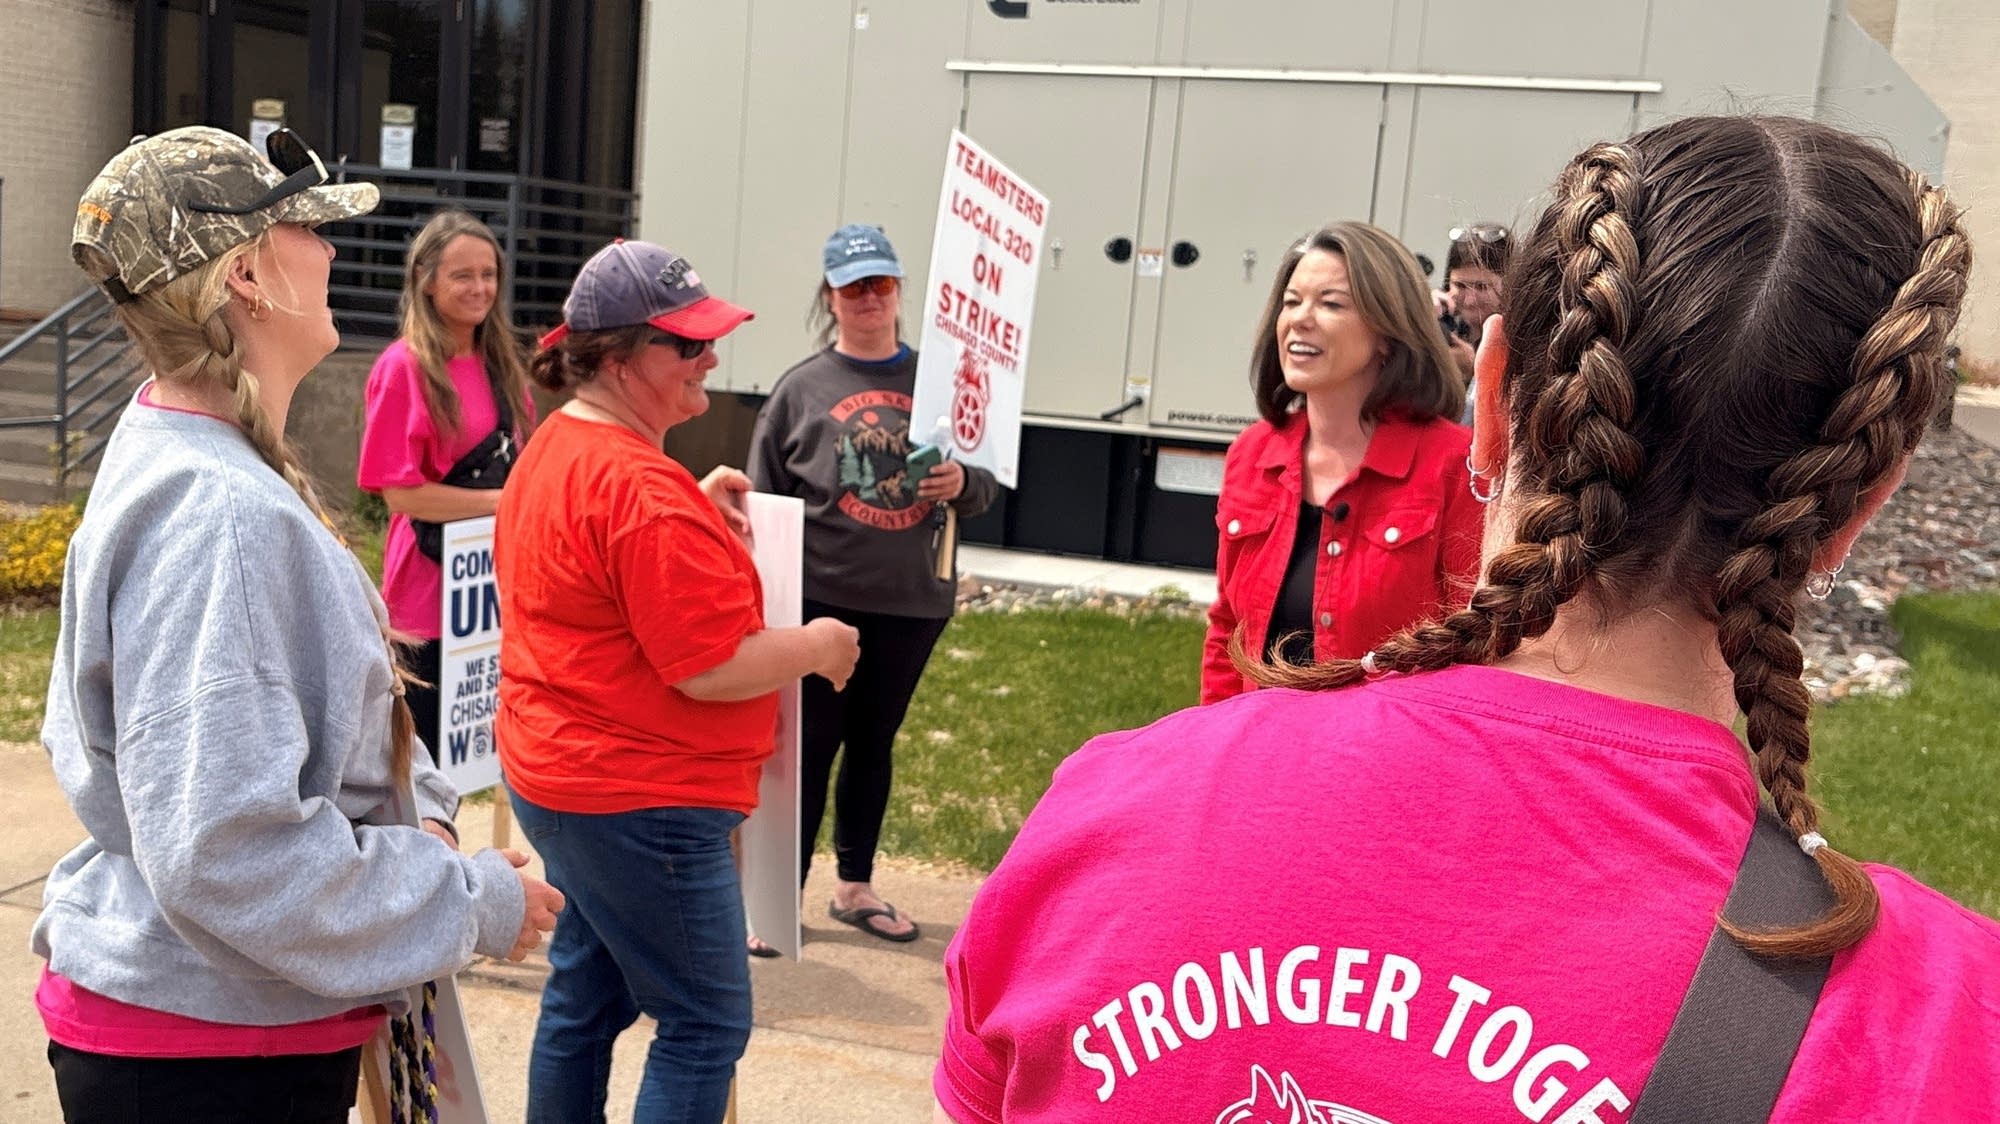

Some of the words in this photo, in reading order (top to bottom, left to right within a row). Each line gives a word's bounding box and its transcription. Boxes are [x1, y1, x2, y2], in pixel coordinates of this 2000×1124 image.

[956, 141, 1044, 227] TEAMSTERS
[951, 190, 1002, 245] LOCAL
[1003, 228, 1034, 265] 320
[972, 253, 1003, 297] ON
[935, 313, 978, 349] CHISAGO
[980, 340, 1018, 372] COUNTY
[938, 283, 1022, 355] STRIKE!
[456, 677, 482, 699] AND
[466, 657, 485, 677] WE
[1072, 945, 1422, 1103] STRONGER
